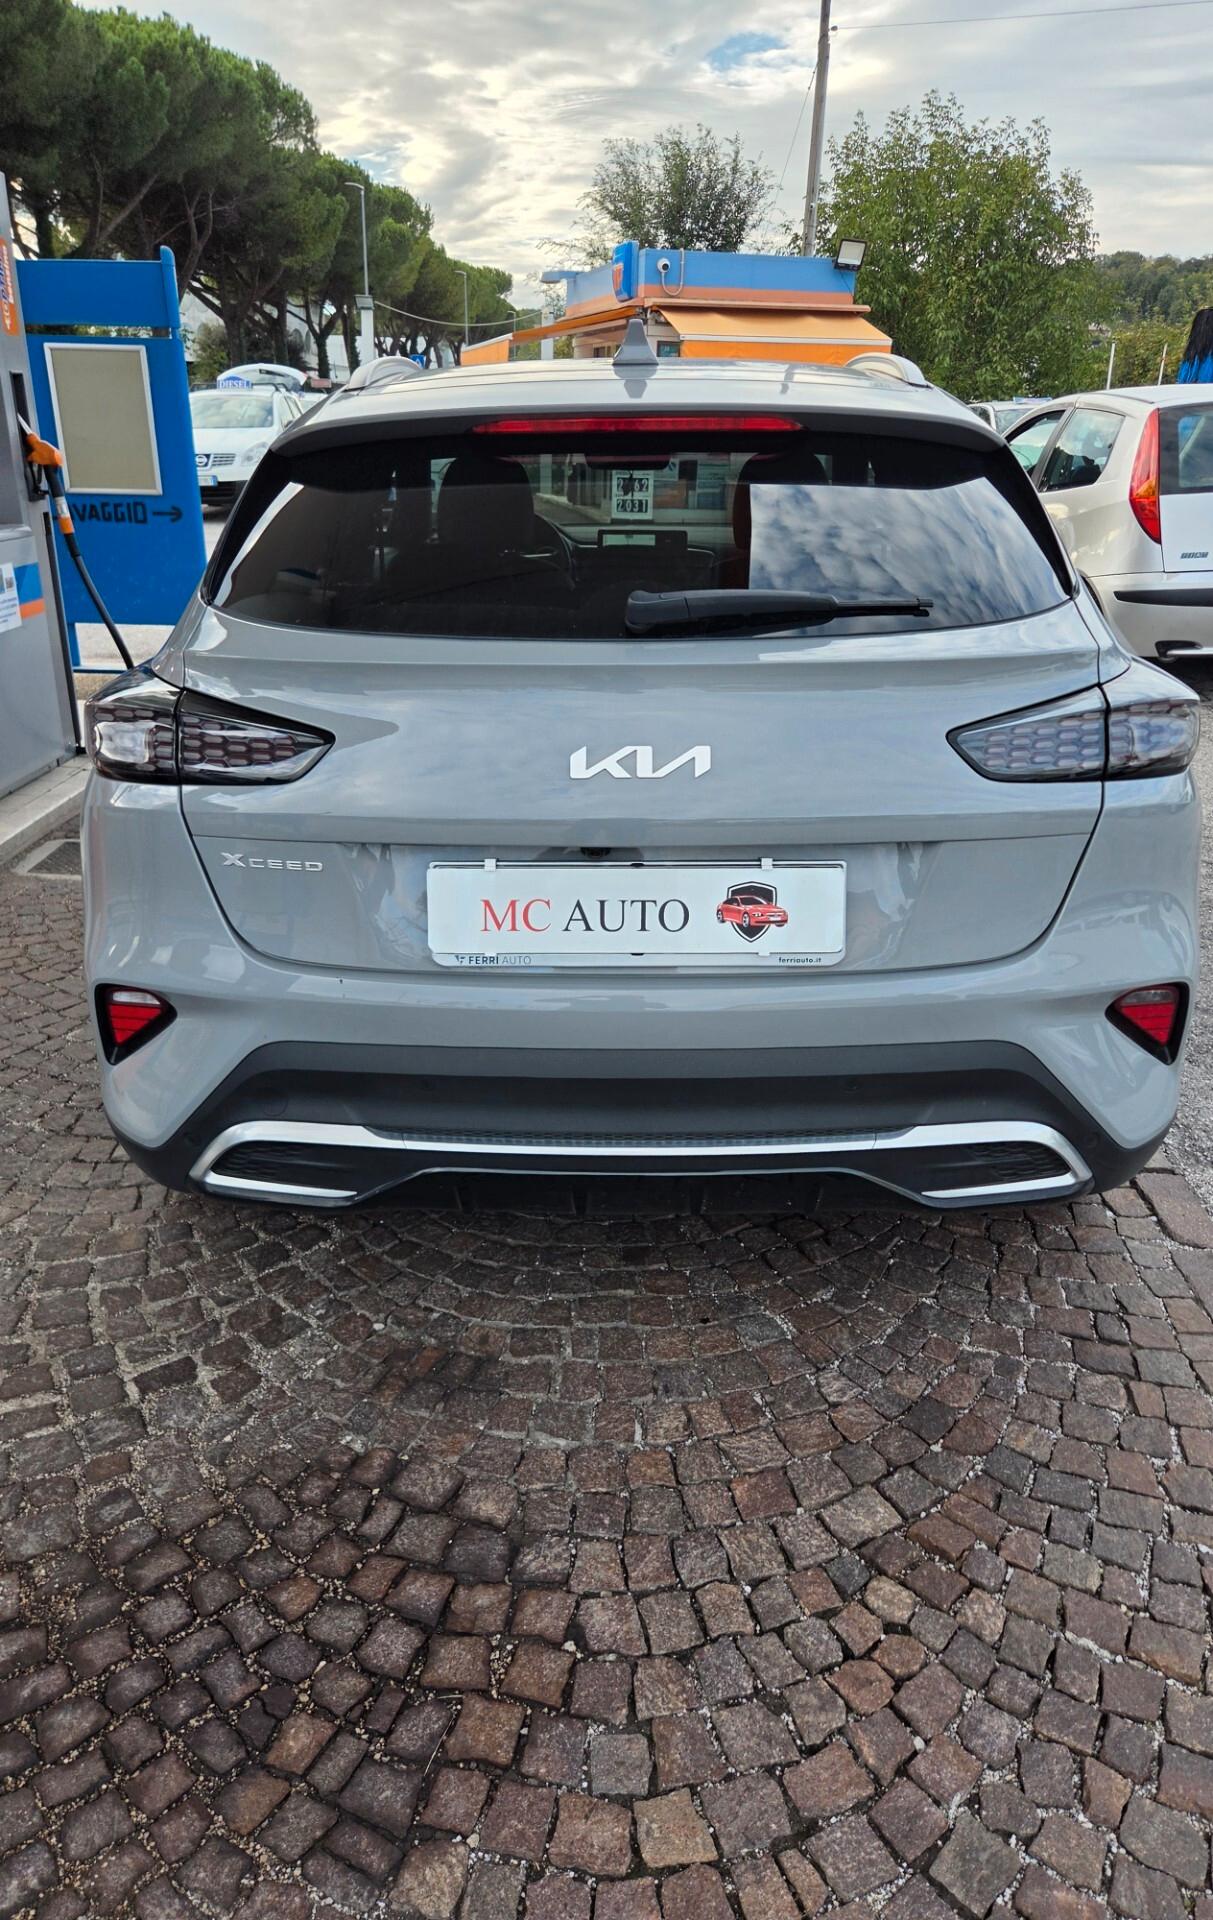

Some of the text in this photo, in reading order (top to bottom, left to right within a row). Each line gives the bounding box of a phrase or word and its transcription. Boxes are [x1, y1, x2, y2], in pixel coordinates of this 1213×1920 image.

[220, 380, 250, 389] DIESEL
[617, 478, 648, 492] 262
[54, 501, 147, 524] VAGGIO
[617, 499, 647, 512] 2031
[570, 745, 711, 779] KIA
[480, 899, 690, 932] MC AUTO
[468, 956, 532, 964] FERRI AUTO
